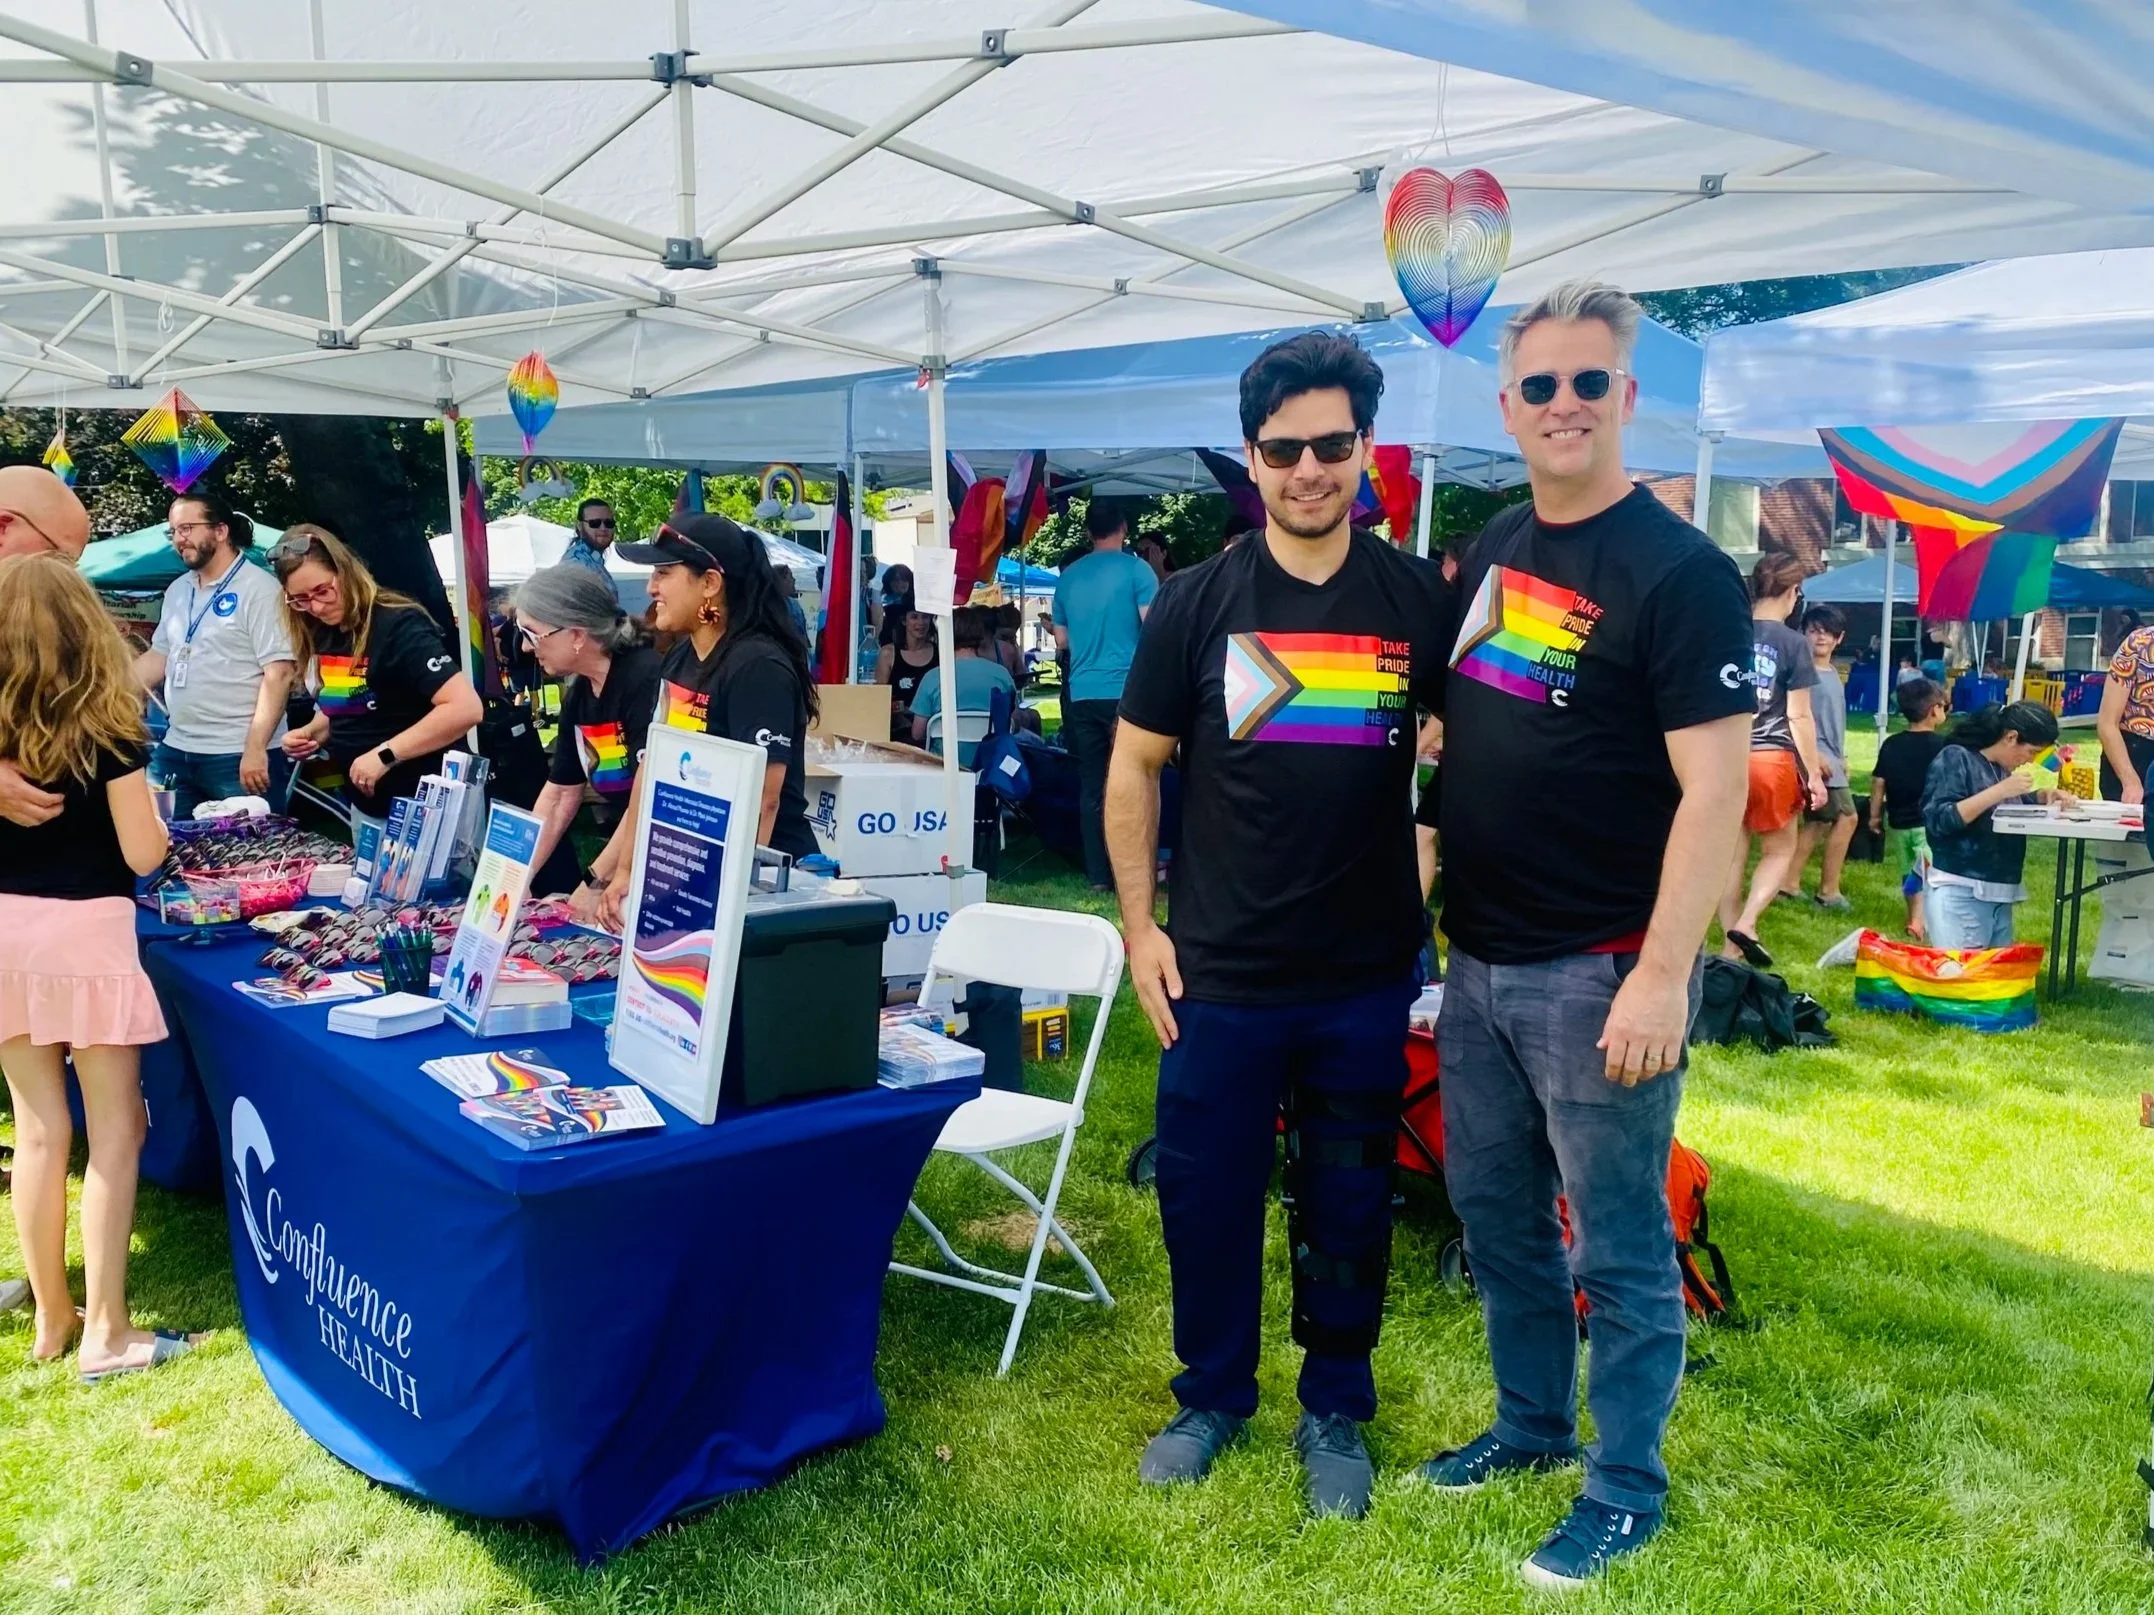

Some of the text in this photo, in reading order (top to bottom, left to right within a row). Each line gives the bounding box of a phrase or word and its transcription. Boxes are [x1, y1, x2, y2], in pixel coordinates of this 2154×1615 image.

[1574, 595, 1604, 619] TAKE
[1562, 614, 1594, 635] PRIDE
[1382, 641, 1410, 656] TAKE
[1569, 636, 1587, 652] IN
[1378, 657, 1410, 674] PRIDE
[1544, 648, 1577, 669] YOUR
[1399, 677, 1410, 691] IN
[1527, 662, 1576, 689] HEALTH
[1379, 693, 1406, 709] YOUR
[819, 790, 836, 811] GO
[857, 812, 896, 835] GO
[892, 910, 950, 935] O US
[266, 1187, 413, 1359] Confluence
[317, 1304, 423, 1420] HEALTH
